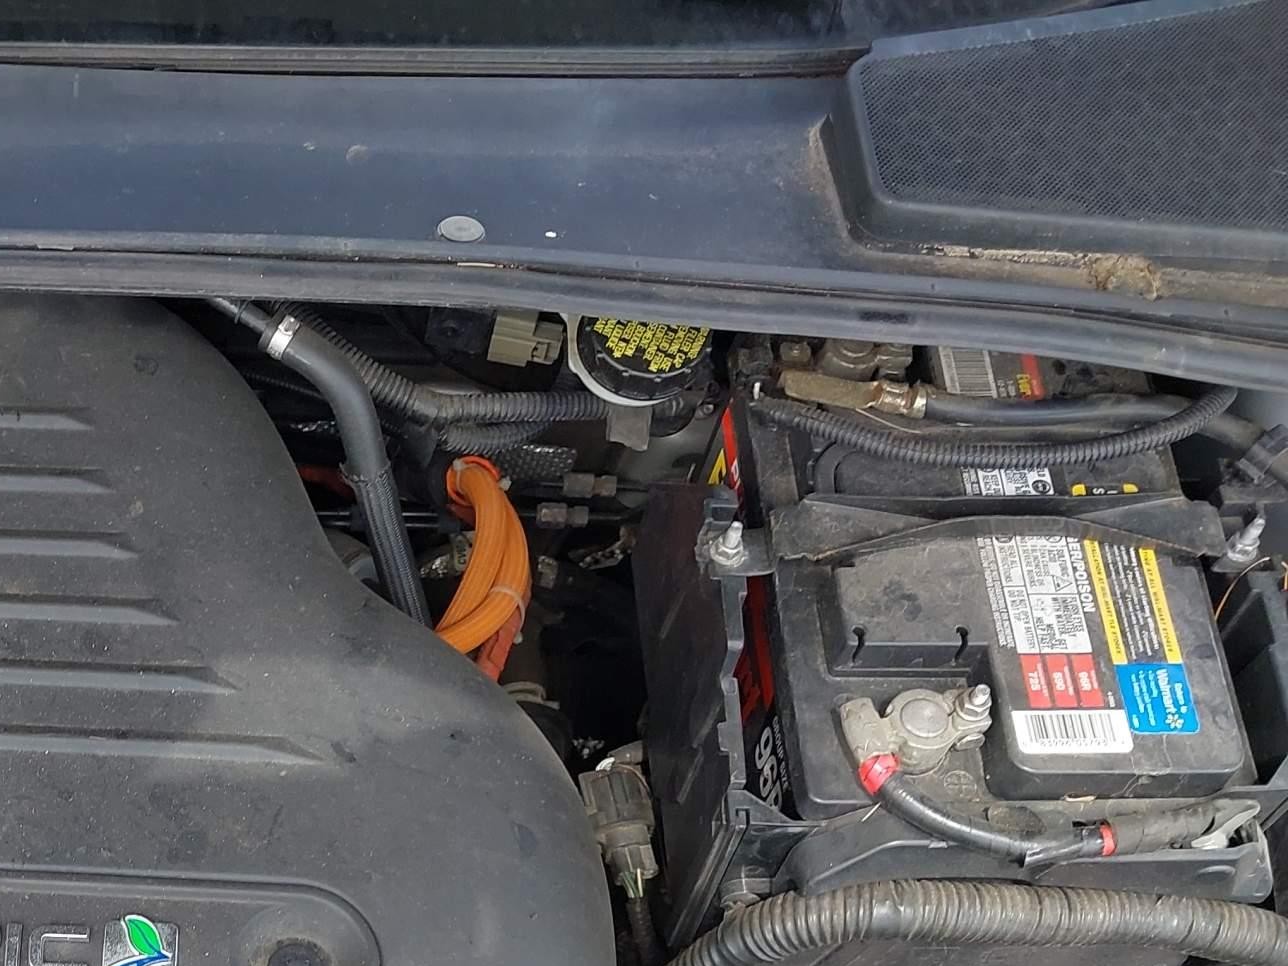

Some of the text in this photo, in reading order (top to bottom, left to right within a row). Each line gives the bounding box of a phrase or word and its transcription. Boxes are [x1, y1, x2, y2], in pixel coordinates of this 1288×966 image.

[606, 324, 624, 349] LIQUIDE
[624, 325, 646, 357] BOUCHON
[659, 330, 674, 351] FLUID
[672, 328, 697, 368] FILLER CAP
[648, 351, 665, 372] FROM
[659, 356, 673, 372] USE
[1050, 597, 1062, 612] WITH
[1058, 596, 1077, 637] IMMEDIATELY
[1072, 617, 1085, 632] EYES
[1026, 671, 1041, 691] 725
[1051, 671, 1066, 691] 590
[1076, 671, 1092, 691] 96R
[1154, 668, 1177, 713] Walmart
